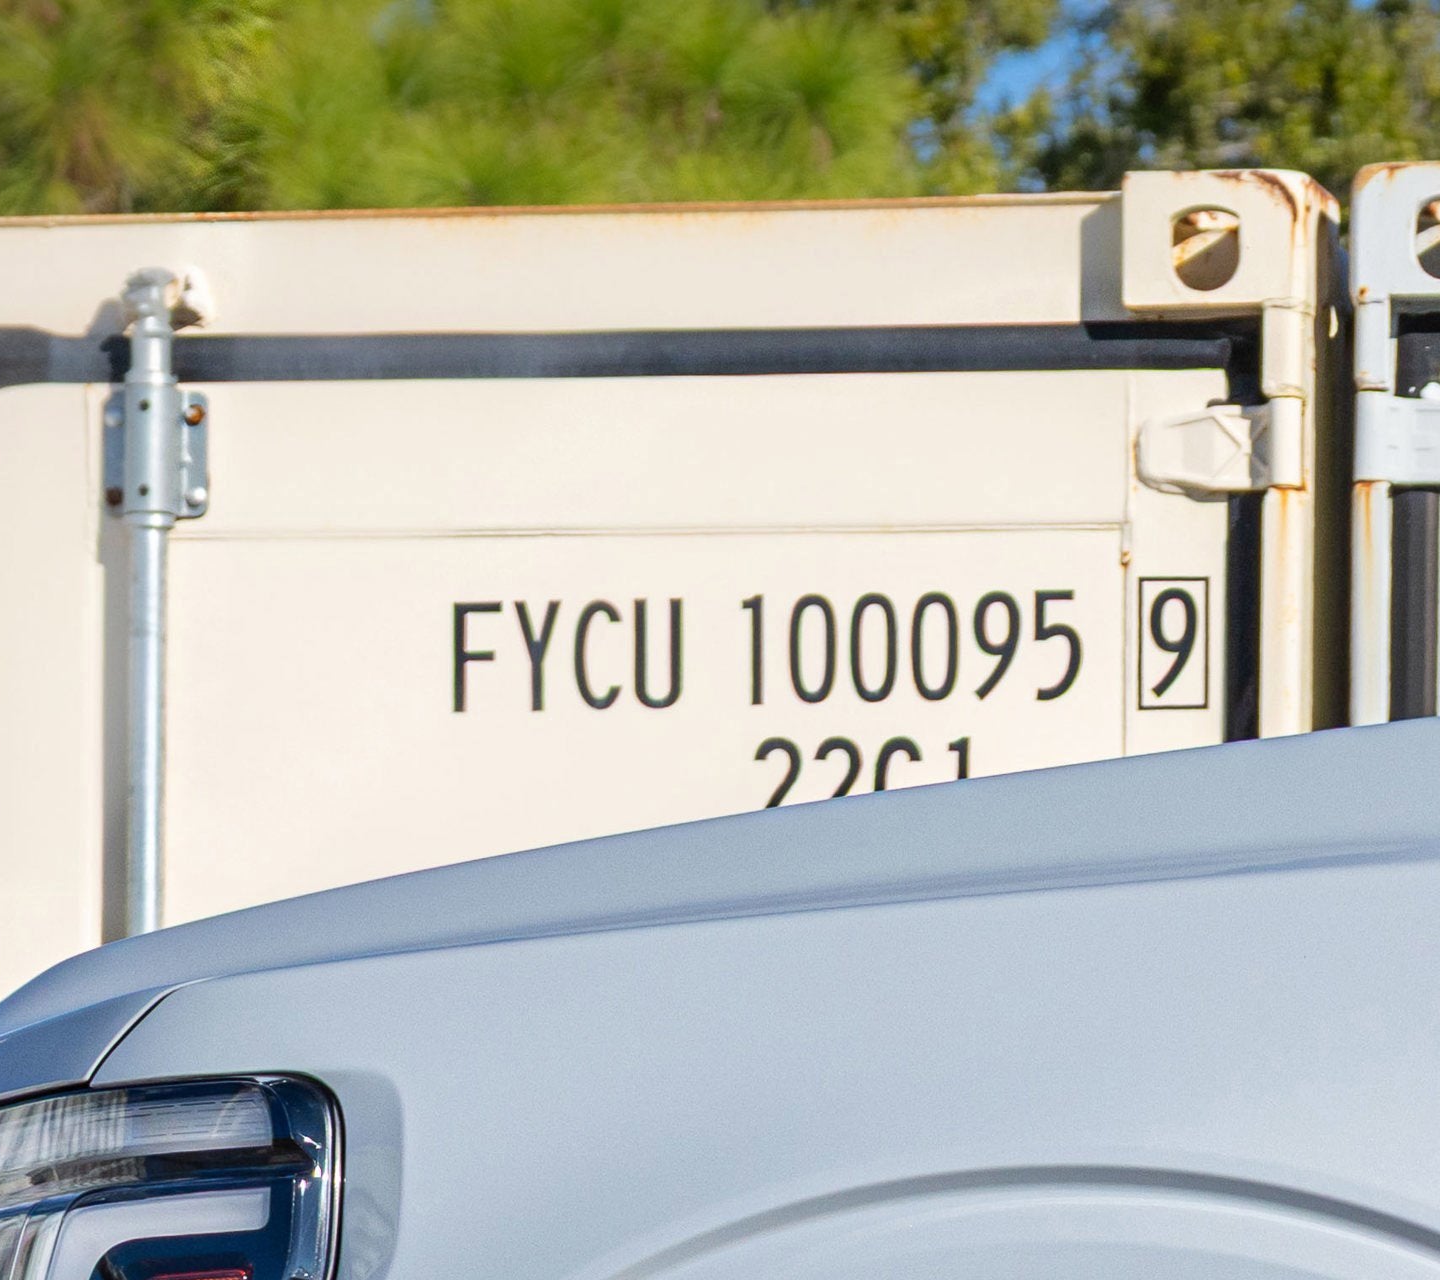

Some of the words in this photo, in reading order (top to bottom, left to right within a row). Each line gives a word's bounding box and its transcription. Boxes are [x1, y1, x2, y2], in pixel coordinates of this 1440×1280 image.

[452, 597, 684, 713] FYCU
[741, 589, 1083, 706] 100095
[1149, 587, 1200, 698] 9
